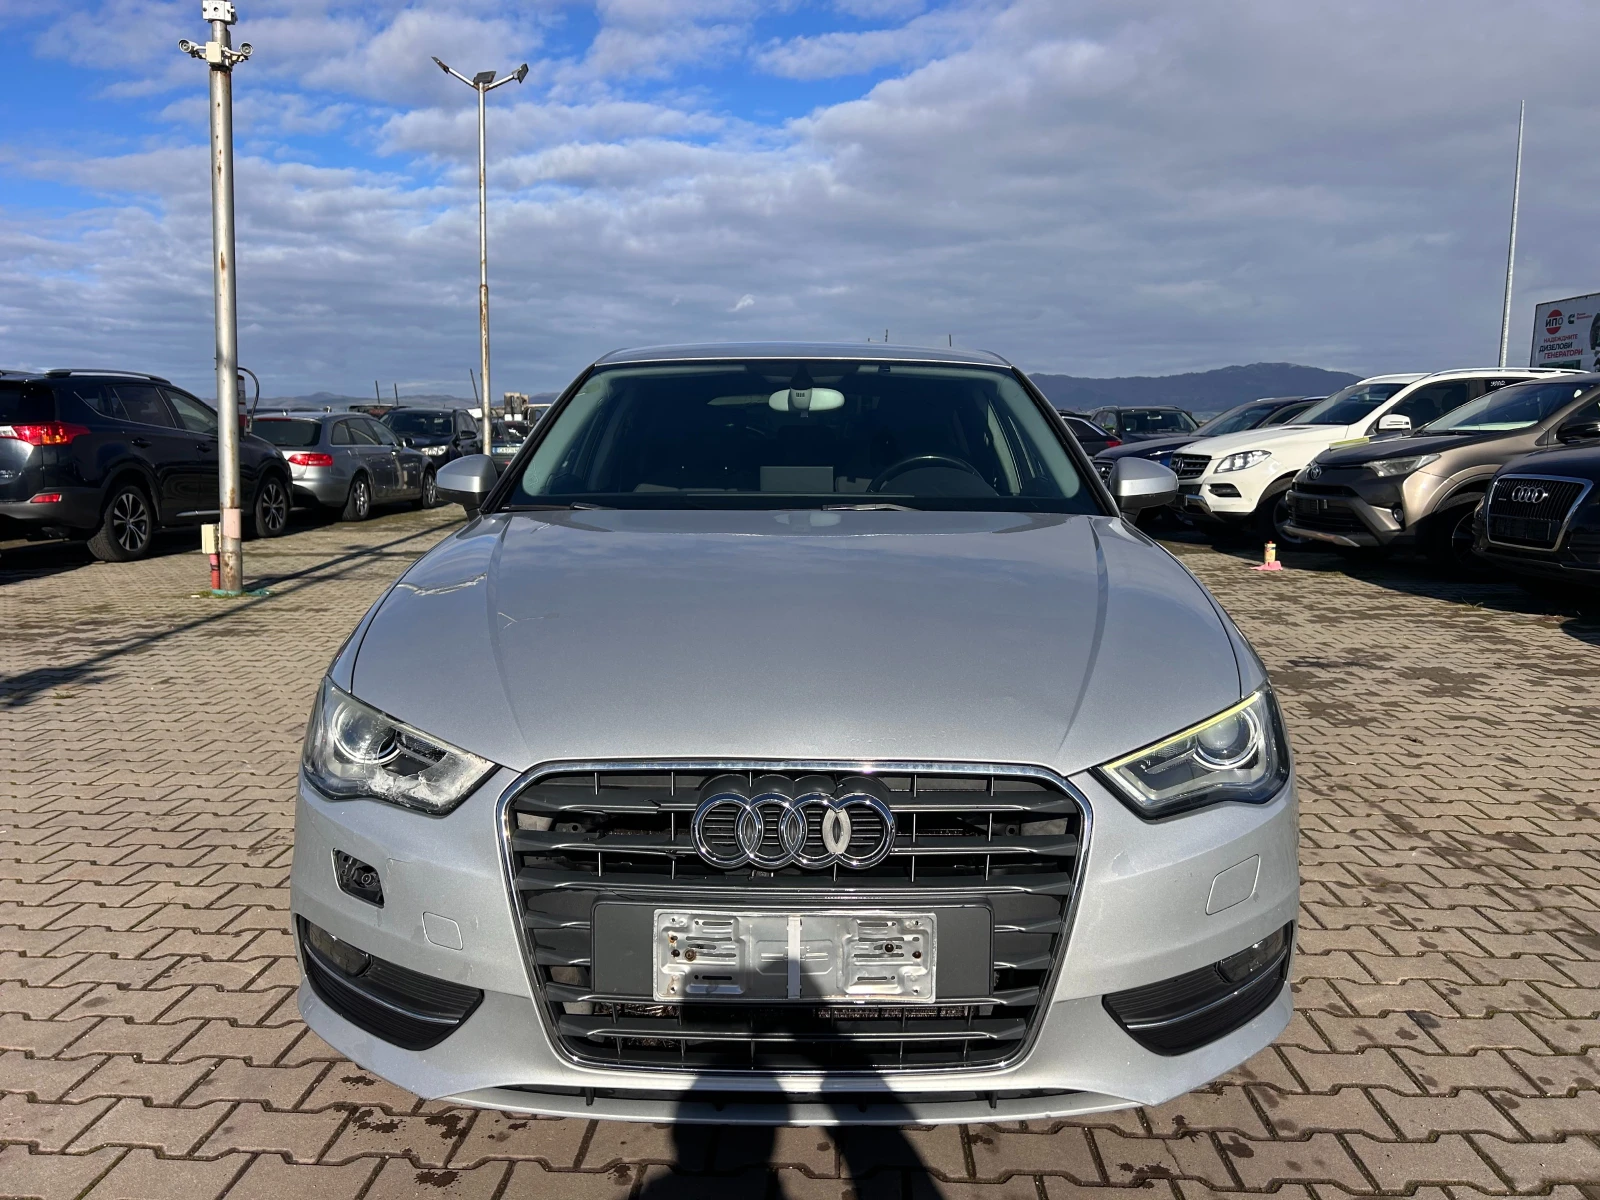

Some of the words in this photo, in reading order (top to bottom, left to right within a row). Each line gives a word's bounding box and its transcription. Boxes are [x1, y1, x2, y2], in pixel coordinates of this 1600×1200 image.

[1545, 317, 1564, 328] ИПО
[1539, 342, 1573, 353] ДИЗЕЛОВИ
[1544, 348, 1583, 359] ГЕНЕРАТОРИ
